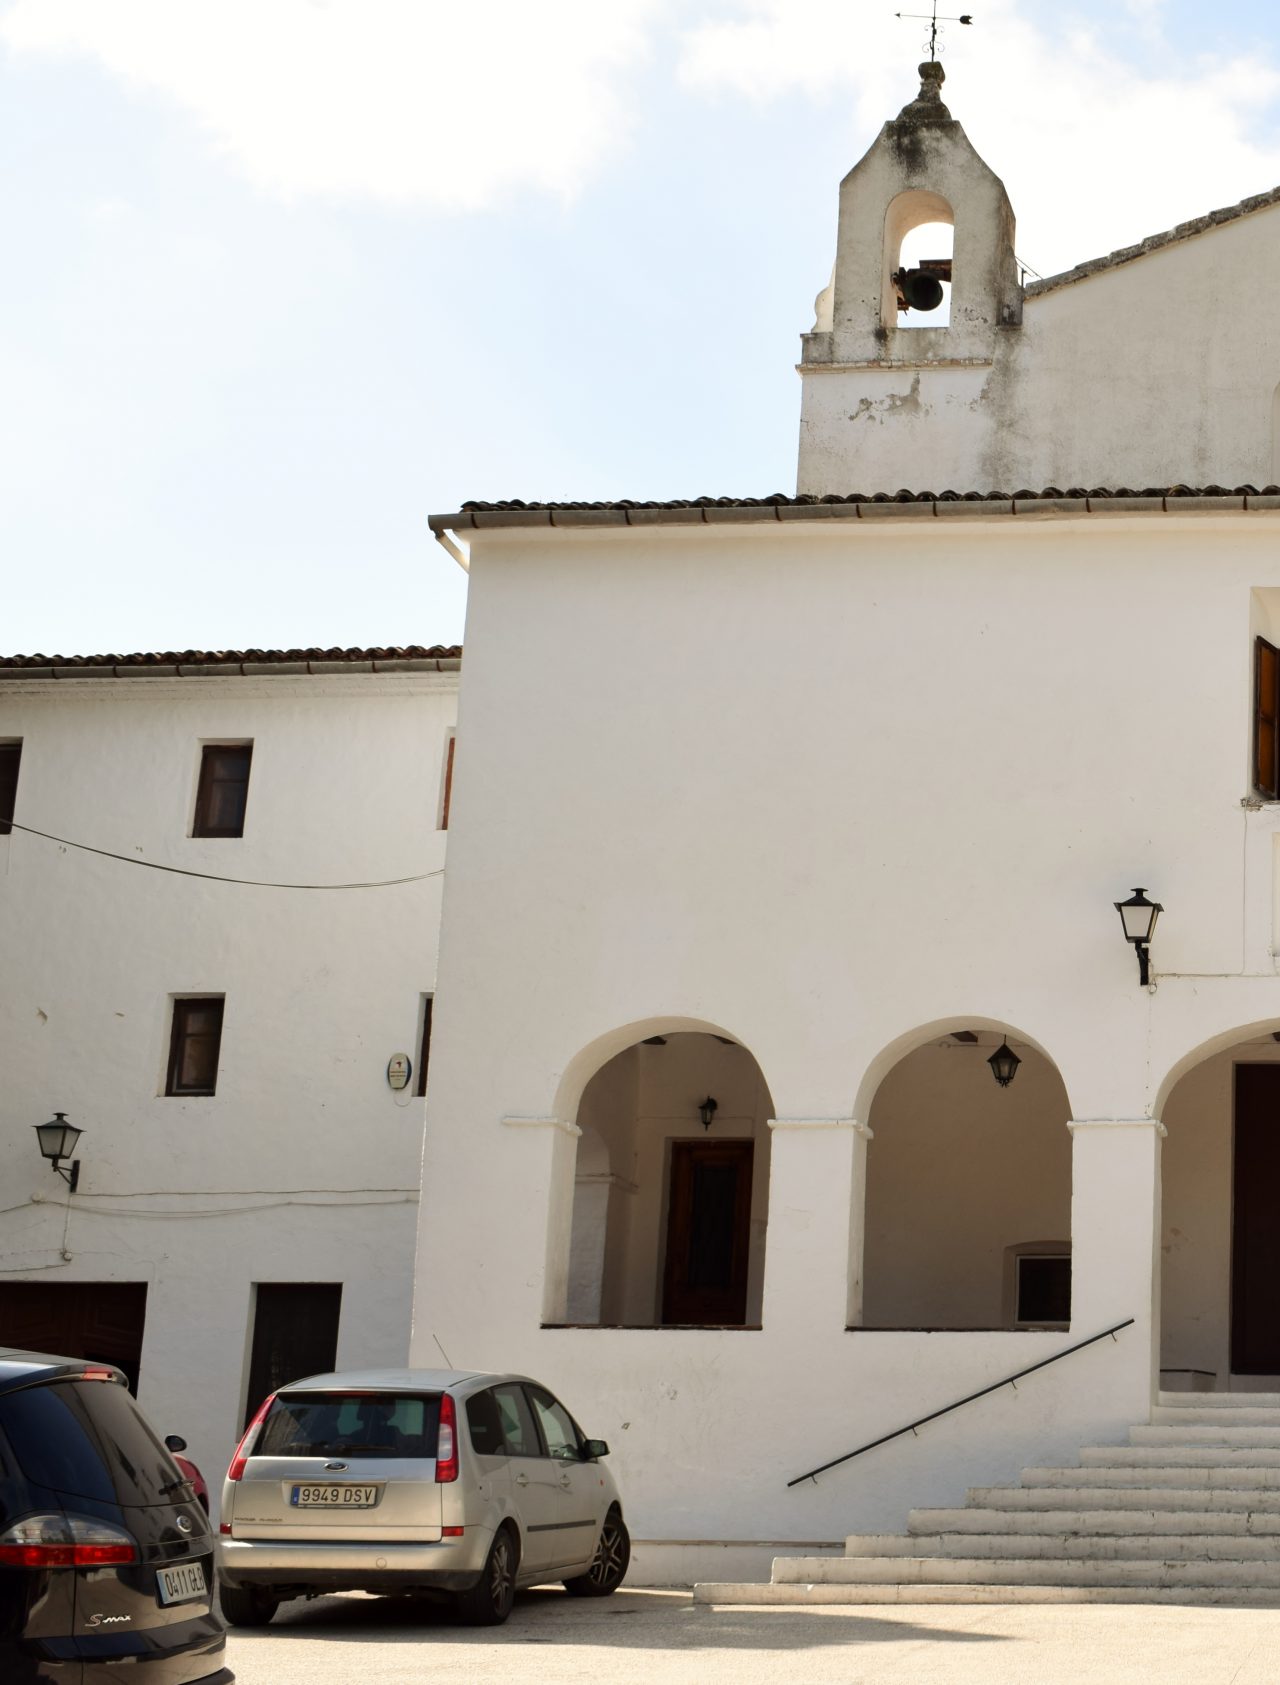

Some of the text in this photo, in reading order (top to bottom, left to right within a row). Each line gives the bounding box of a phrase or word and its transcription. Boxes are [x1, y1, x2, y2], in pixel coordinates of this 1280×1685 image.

[302, 1488, 340, 1502] 9949
[343, 1488, 373, 1503] DSV
[164, 1569, 189, 1597] 0411
